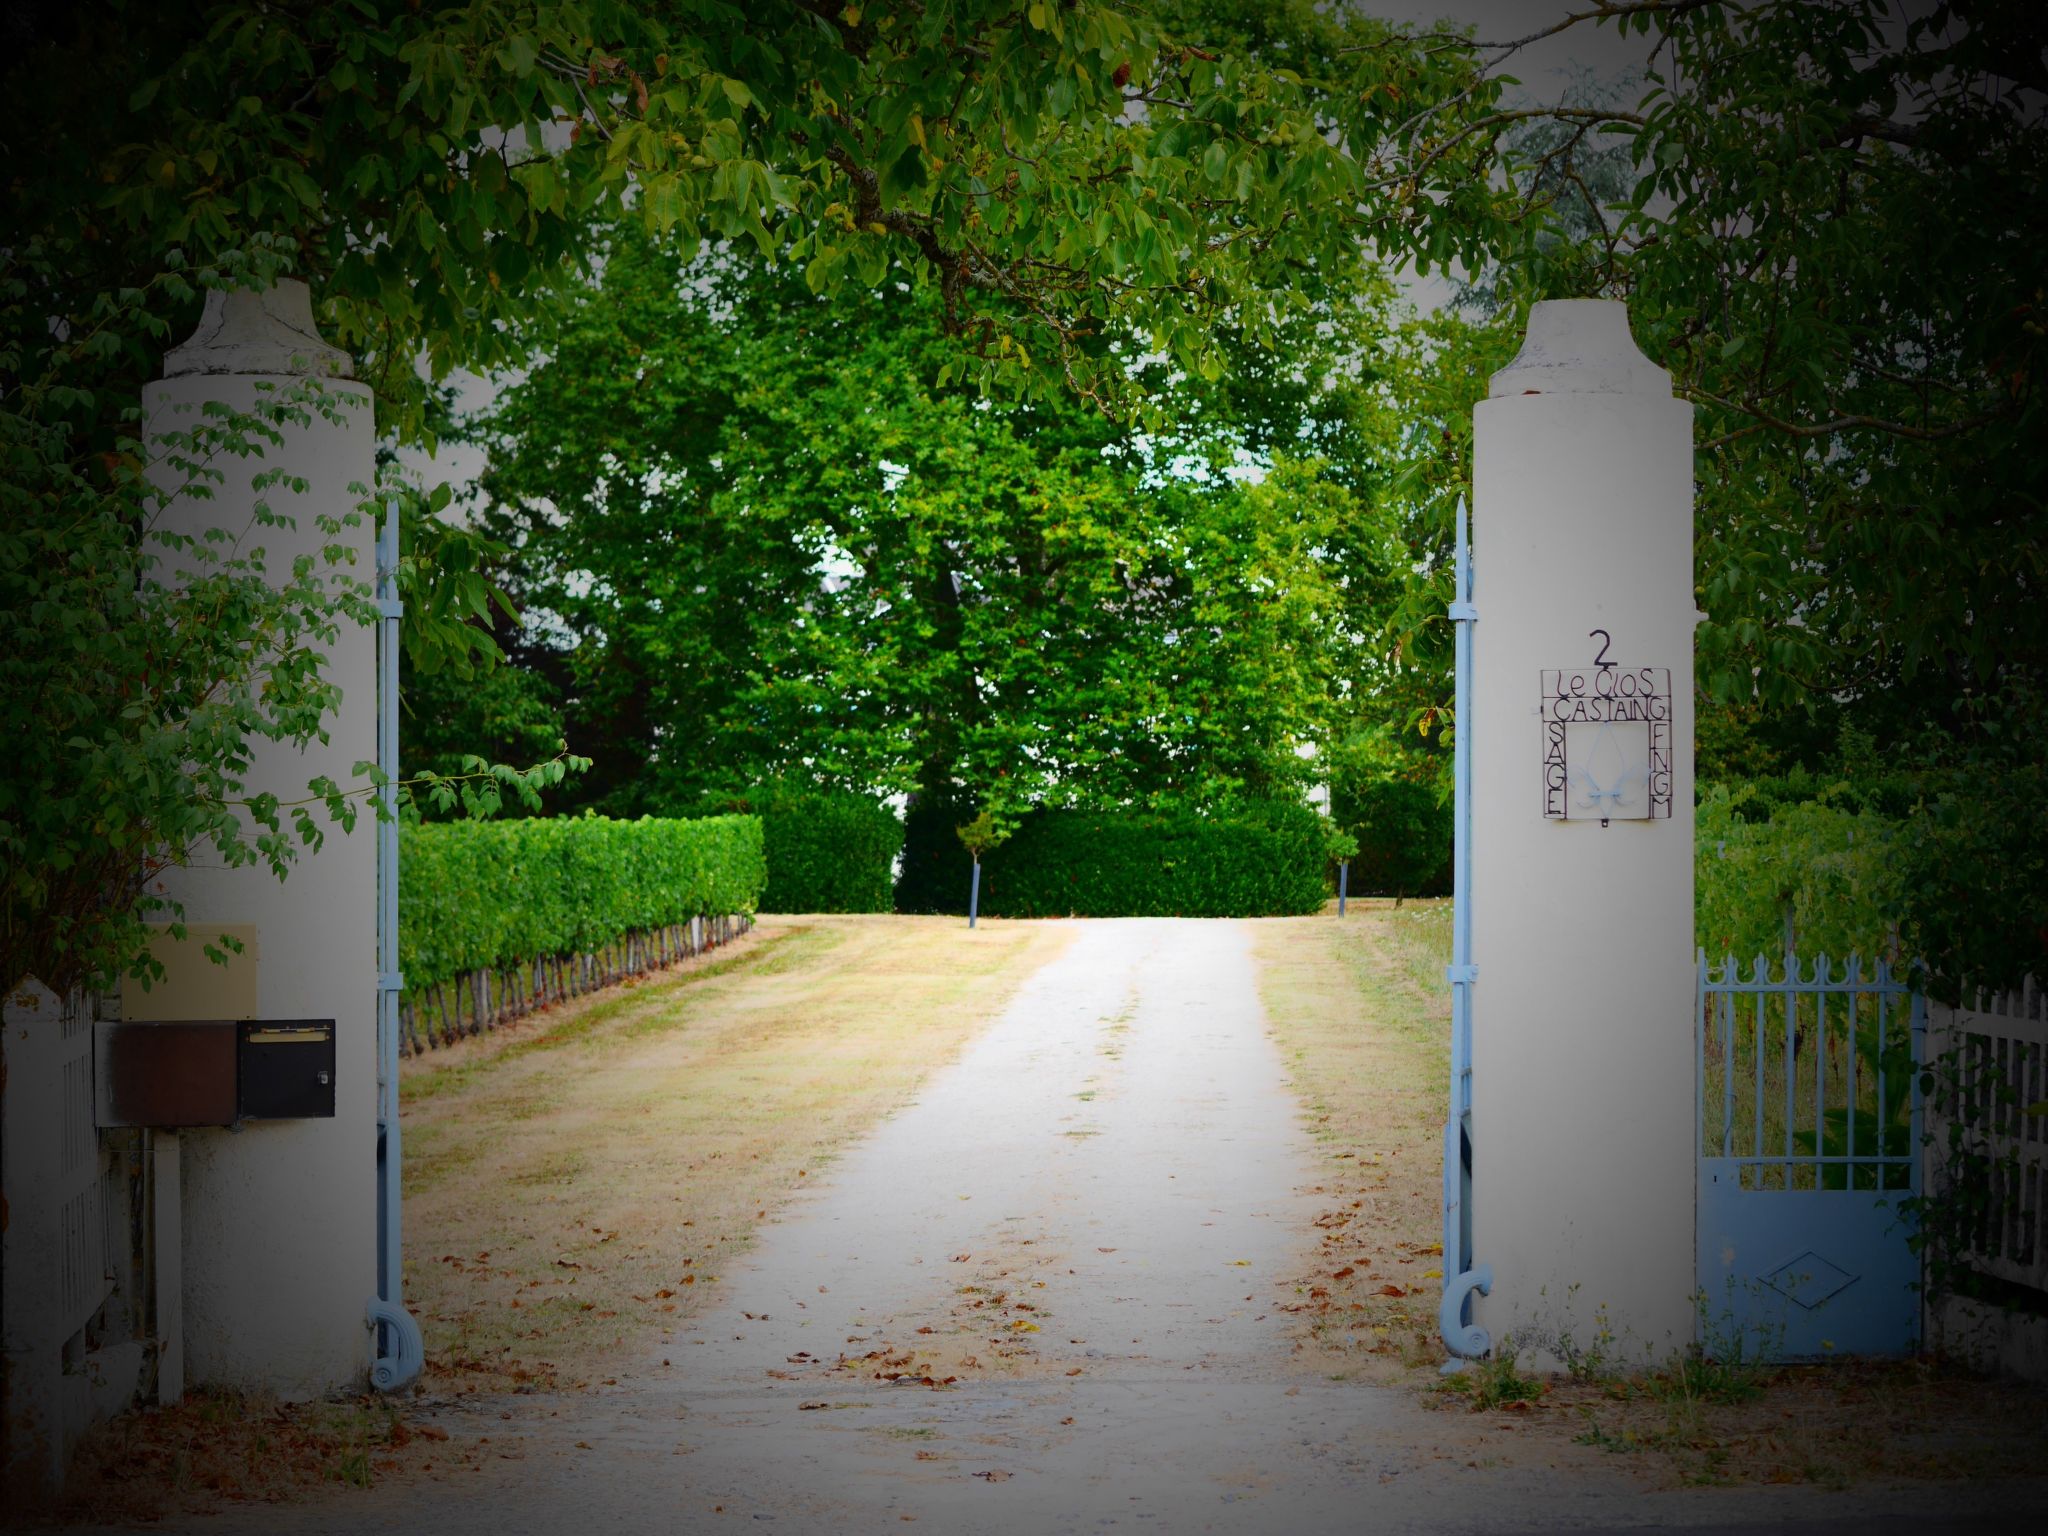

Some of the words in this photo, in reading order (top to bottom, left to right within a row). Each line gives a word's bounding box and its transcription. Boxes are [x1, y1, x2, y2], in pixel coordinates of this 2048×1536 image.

[1589, 629, 1618, 666] 2
[1553, 697, 1666, 721] CASTAING
[1546, 721, 1567, 815] SAGE
